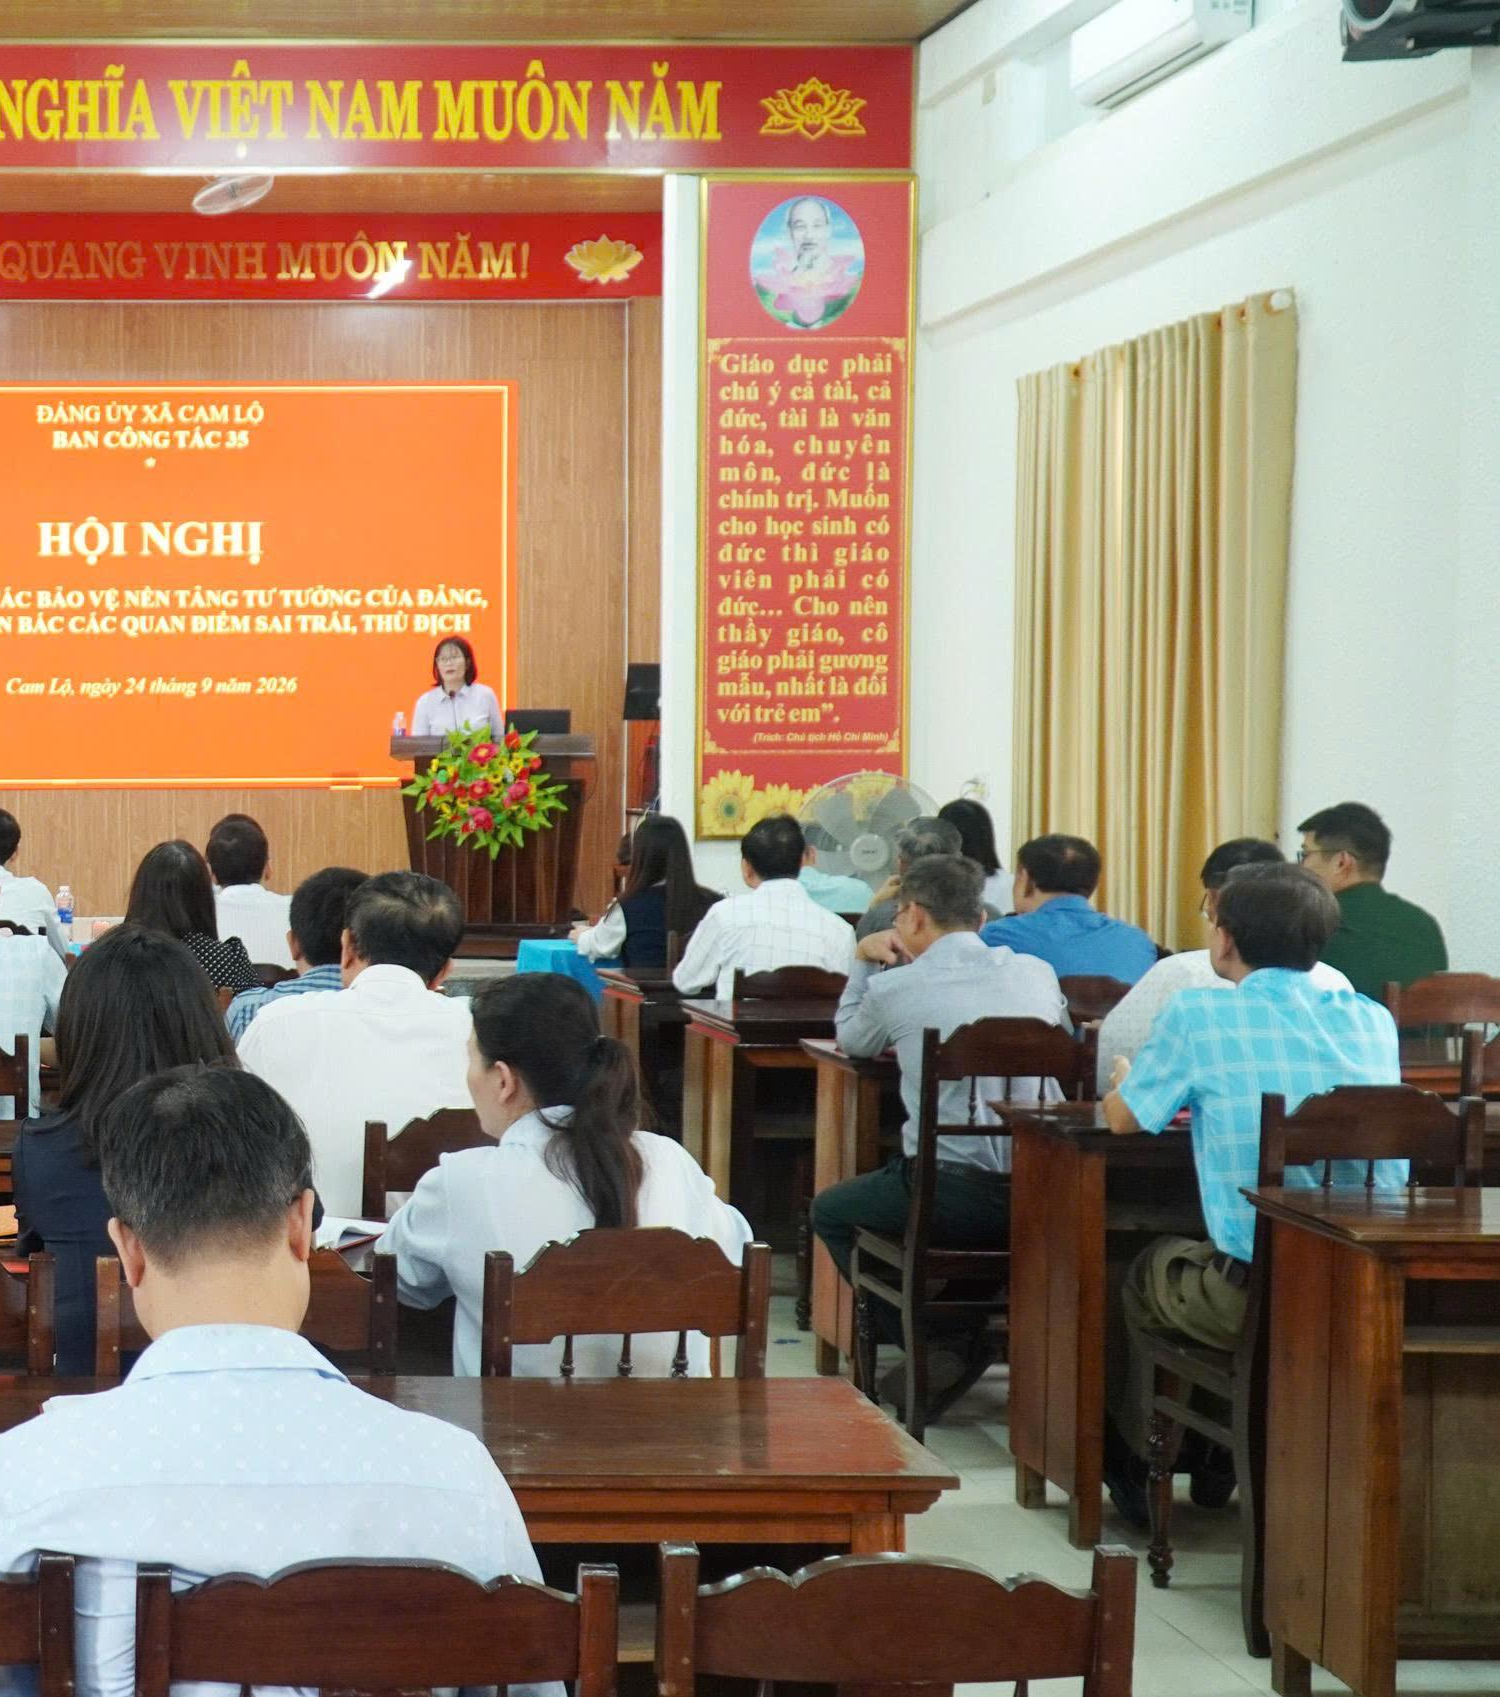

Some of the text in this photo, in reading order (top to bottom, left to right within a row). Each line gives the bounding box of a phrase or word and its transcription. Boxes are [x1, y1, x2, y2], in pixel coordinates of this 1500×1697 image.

[169, 59, 293, 157] VIỆT
[305, 79, 422, 140] NAM
[434, 59, 590, 140] MUÔN
[606, 61, 722, 141] NĂM
[154, 241, 266, 280] VINH
[277, 230, 407, 280] MUÔN
[418, 232, 530, 280] NĂM!
[787, 353, 829, 378] dục
[719, 380, 759, 401] chú
[768, 380, 782, 406] ý
[824, 380, 859, 404] tài,
[36, 400, 264, 426] ĐẢNG ỦY XÃ CAM LỘ
[719, 407, 891, 431] đức, tài là văn
[52, 430, 99, 449] BAN
[103, 425, 169, 449] CÔNG
[175, 426, 221, 449] TÁC
[719, 434, 890, 460] hóa, chuyên
[719, 460, 890, 485] môn, đức là
[719, 483, 889, 513] chính trị. Muốn
[719, 515, 890, 540] cho học sinh có
[38, 516, 263, 566] HỘI NGHỊ
[718, 541, 890, 567] đức thì giáo
[718, 568, 772, 589] viên
[861, 568, 889, 589] có
[88, 588, 119, 612] VỆ
[243, 588, 276, 608] TƯ
[365, 584, 414, 608] CỦA
[717, 595, 888, 616] đức... Cho nên
[18, 611, 65, 634] BÁC
[68, 611, 117, 634] CÁC
[121, 615, 187, 637] QUAN
[255, 614, 292, 634] SAI
[414, 614, 471, 637] ĐỊCH
[717, 617, 888, 648] thầy giáo, cô
[718, 649, 762, 675] giáo
[820, 654, 887, 675] gương
[5, 677, 45, 695] Cam
[80, 677, 121, 698] ngày
[124, 677, 146, 695] 24
[149, 677, 198, 698] tháng
[201, 677, 213, 695] 9
[215, 677, 252, 695] năm
[256, 676, 298, 695] 2026
[776, 670, 824, 695] nhất
[830, 674, 849, 695] là
[717, 702, 751, 722] với
